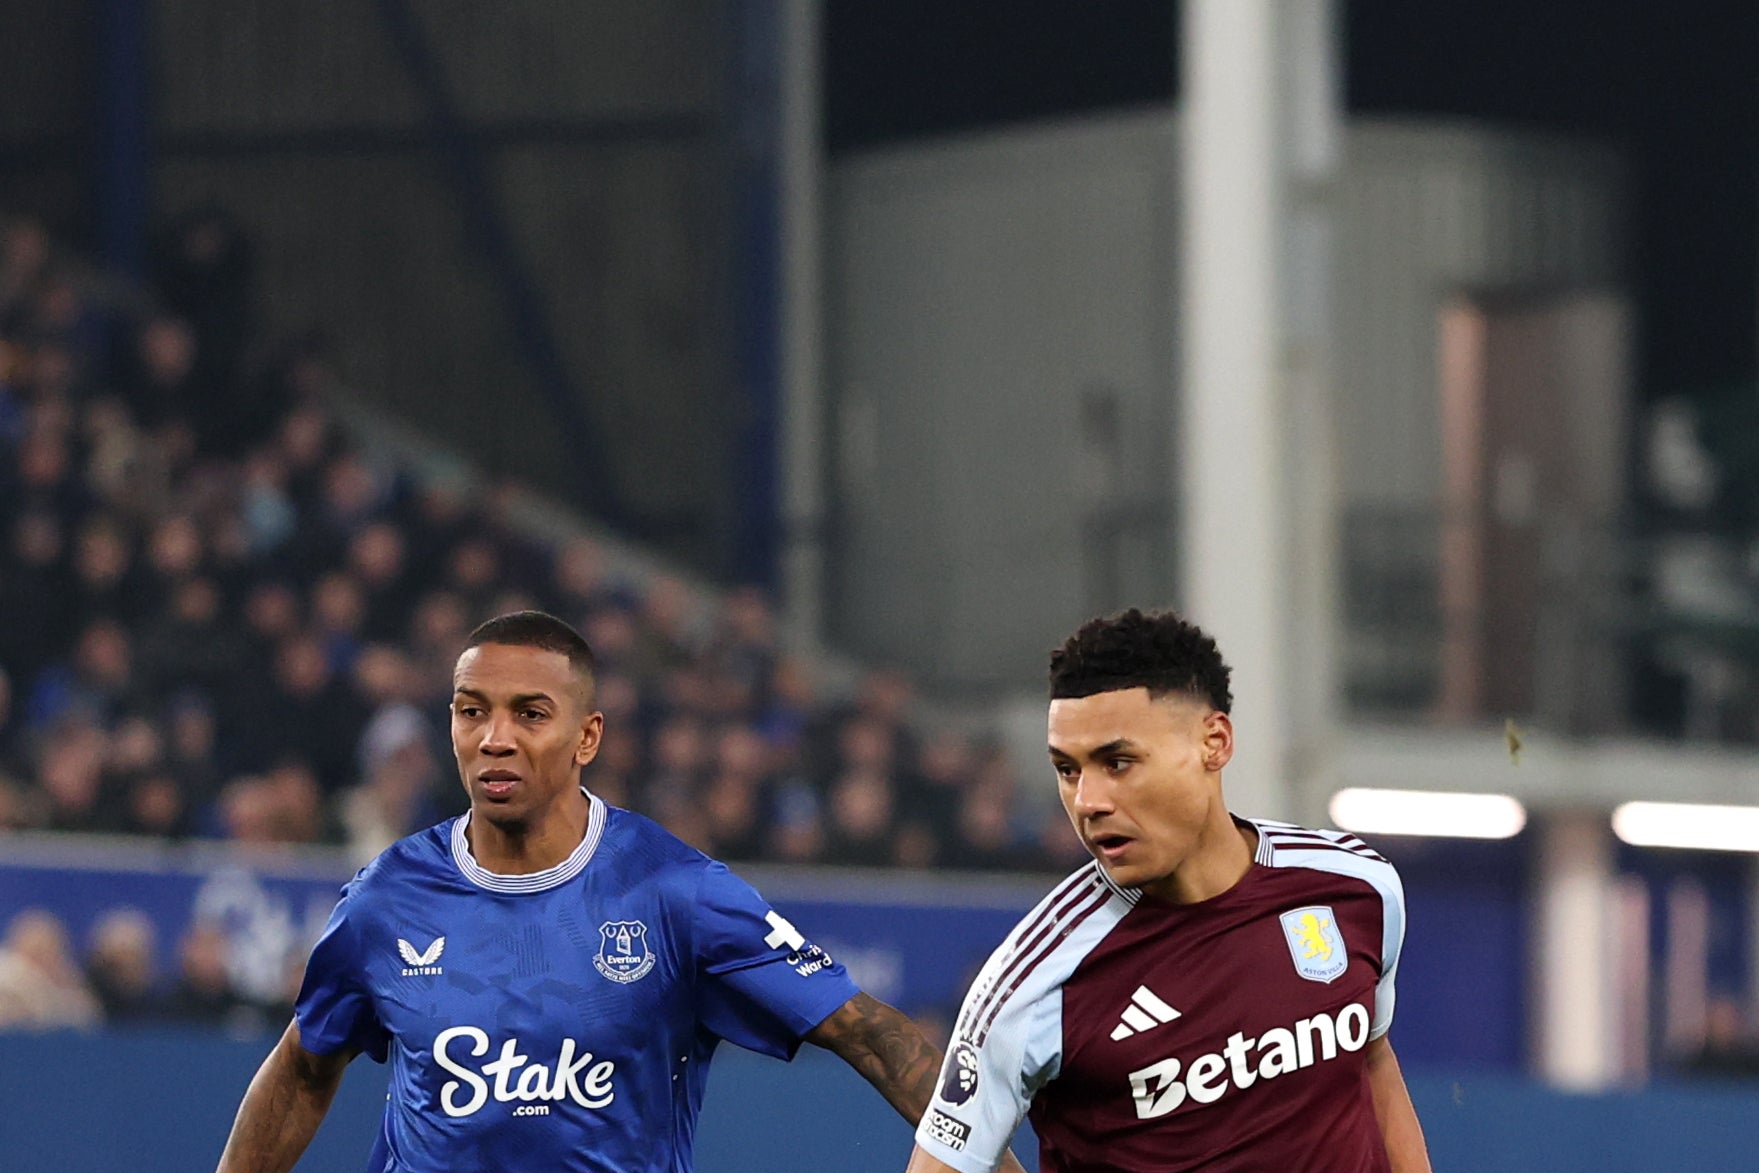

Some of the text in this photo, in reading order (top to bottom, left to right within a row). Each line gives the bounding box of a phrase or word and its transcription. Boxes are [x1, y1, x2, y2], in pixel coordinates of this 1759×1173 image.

[607, 955, 641, 964] Everton
[795, 953, 832, 977] Ward
[402, 967, 443, 977] CASTORE
[1303, 967, 1327, 976] ASTON
[1128, 1003, 1370, 1119] Betano
[433, 1026, 615, 1117] Stake
[512, 1105, 549, 1116] .com
